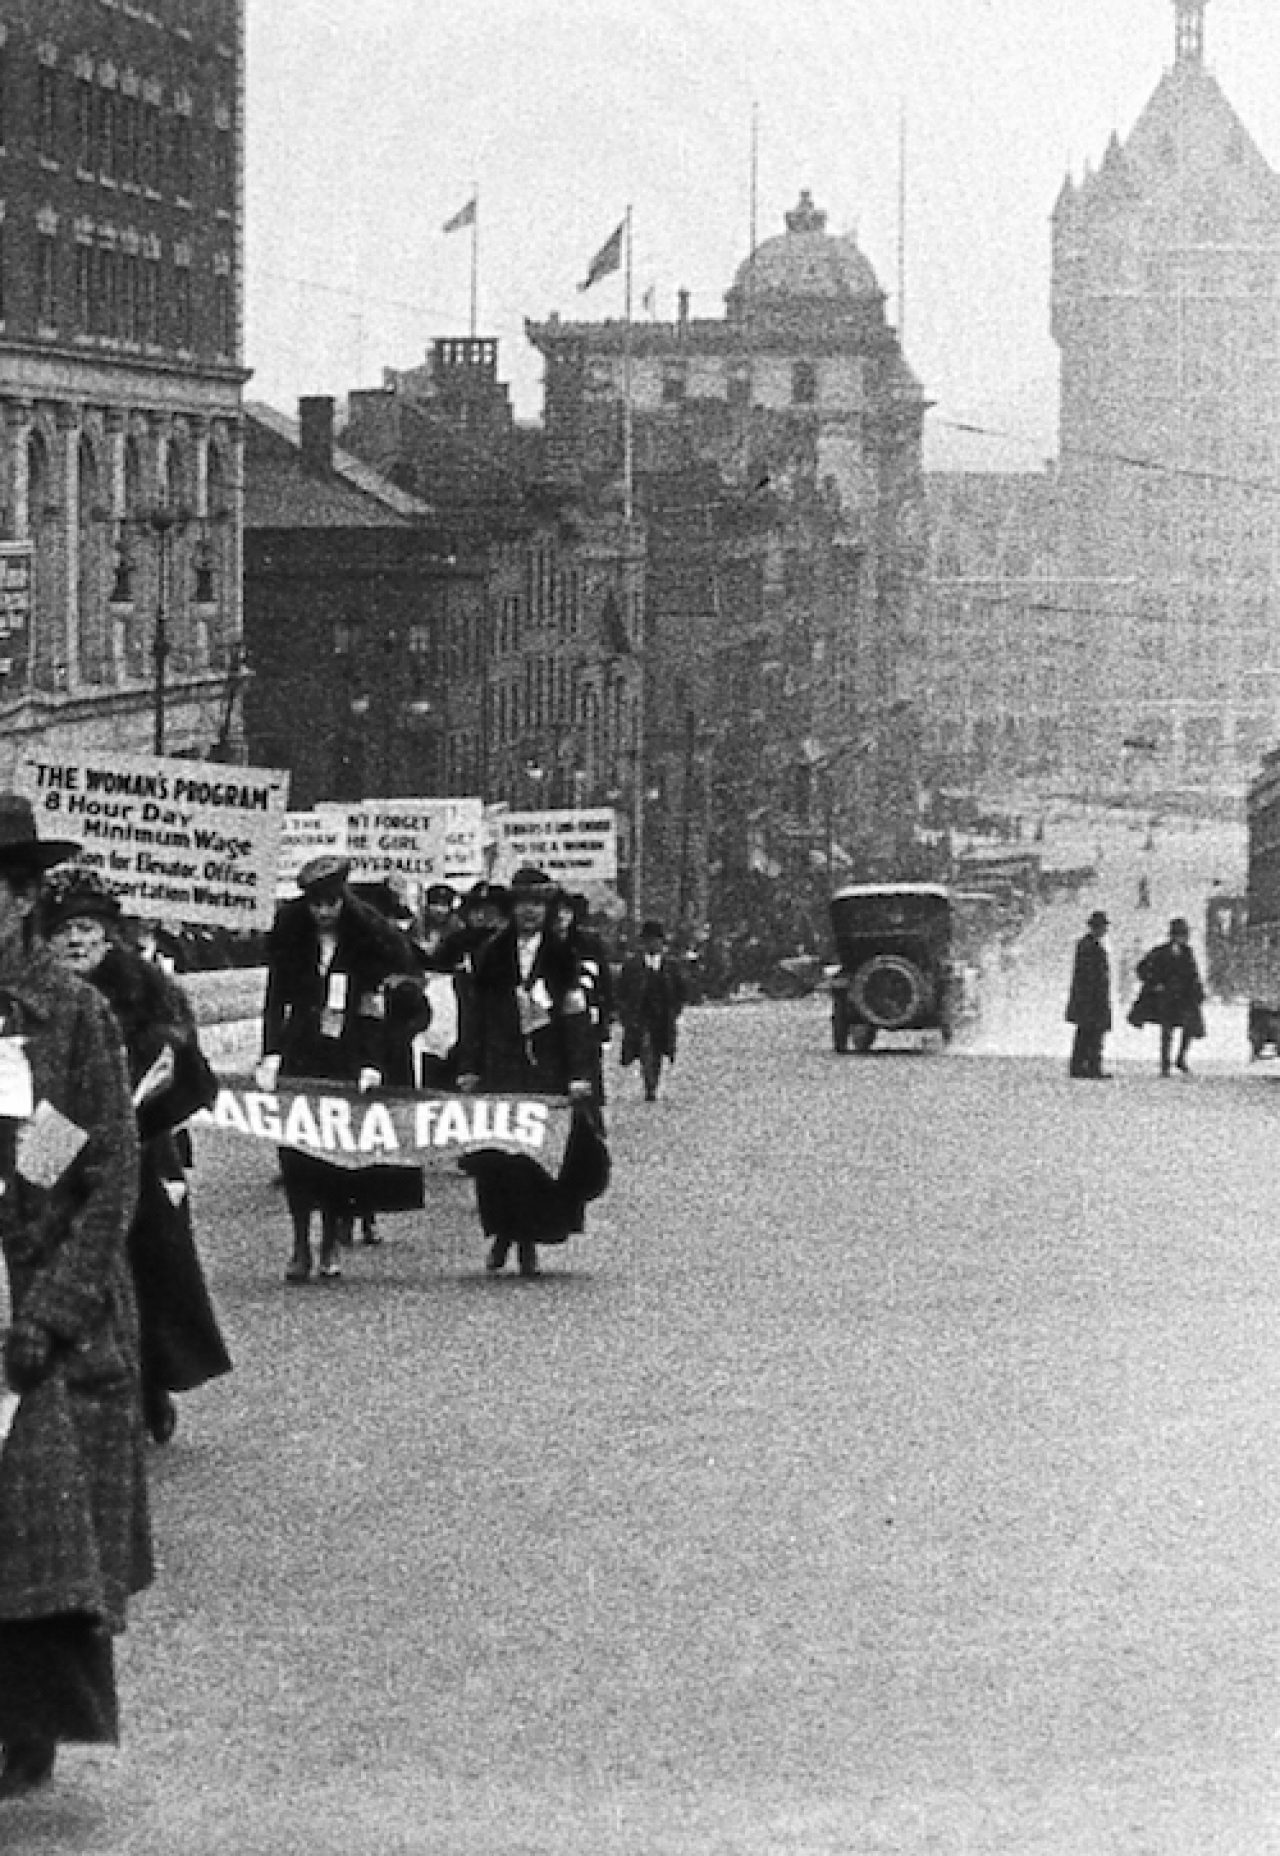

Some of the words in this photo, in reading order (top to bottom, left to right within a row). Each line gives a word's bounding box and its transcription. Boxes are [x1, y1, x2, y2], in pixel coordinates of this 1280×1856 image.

[86, 769, 167, 800] WOMAN'S
[45, 791, 61, 810] 8
[68, 795, 135, 818] Hour
[142, 803, 193, 828] Day
[375, 815, 432, 831] FORGET
[83, 819, 190, 848] Minimum
[194, 829, 252, 860] Wage
[204, 861, 258, 887] Office
[193, 886, 257, 910] Workers
[212, 1089, 400, 1151] AGARA
[416, 1099, 549, 1149] FALLS
